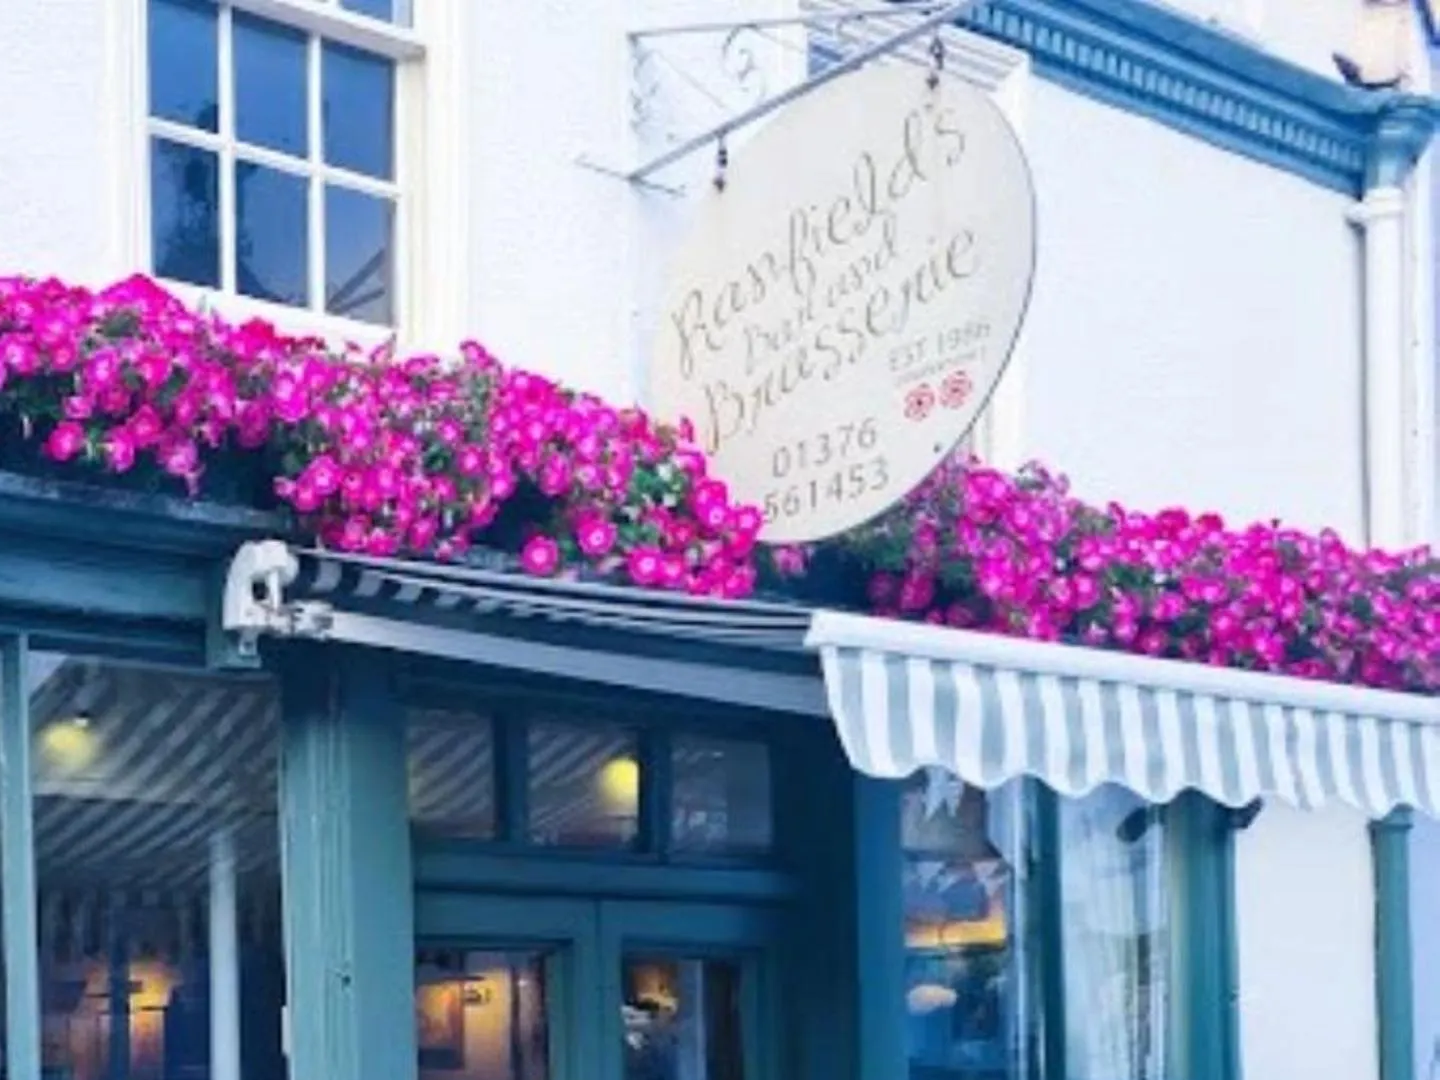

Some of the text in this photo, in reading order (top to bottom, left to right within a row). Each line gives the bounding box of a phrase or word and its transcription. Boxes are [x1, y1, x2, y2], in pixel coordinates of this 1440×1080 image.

[670, 101, 966, 382] Ranfield's
[702, 226, 982, 458] Brasserie
[761, 456, 891, 527] 561453
[771, 416, 879, 481] 01376
